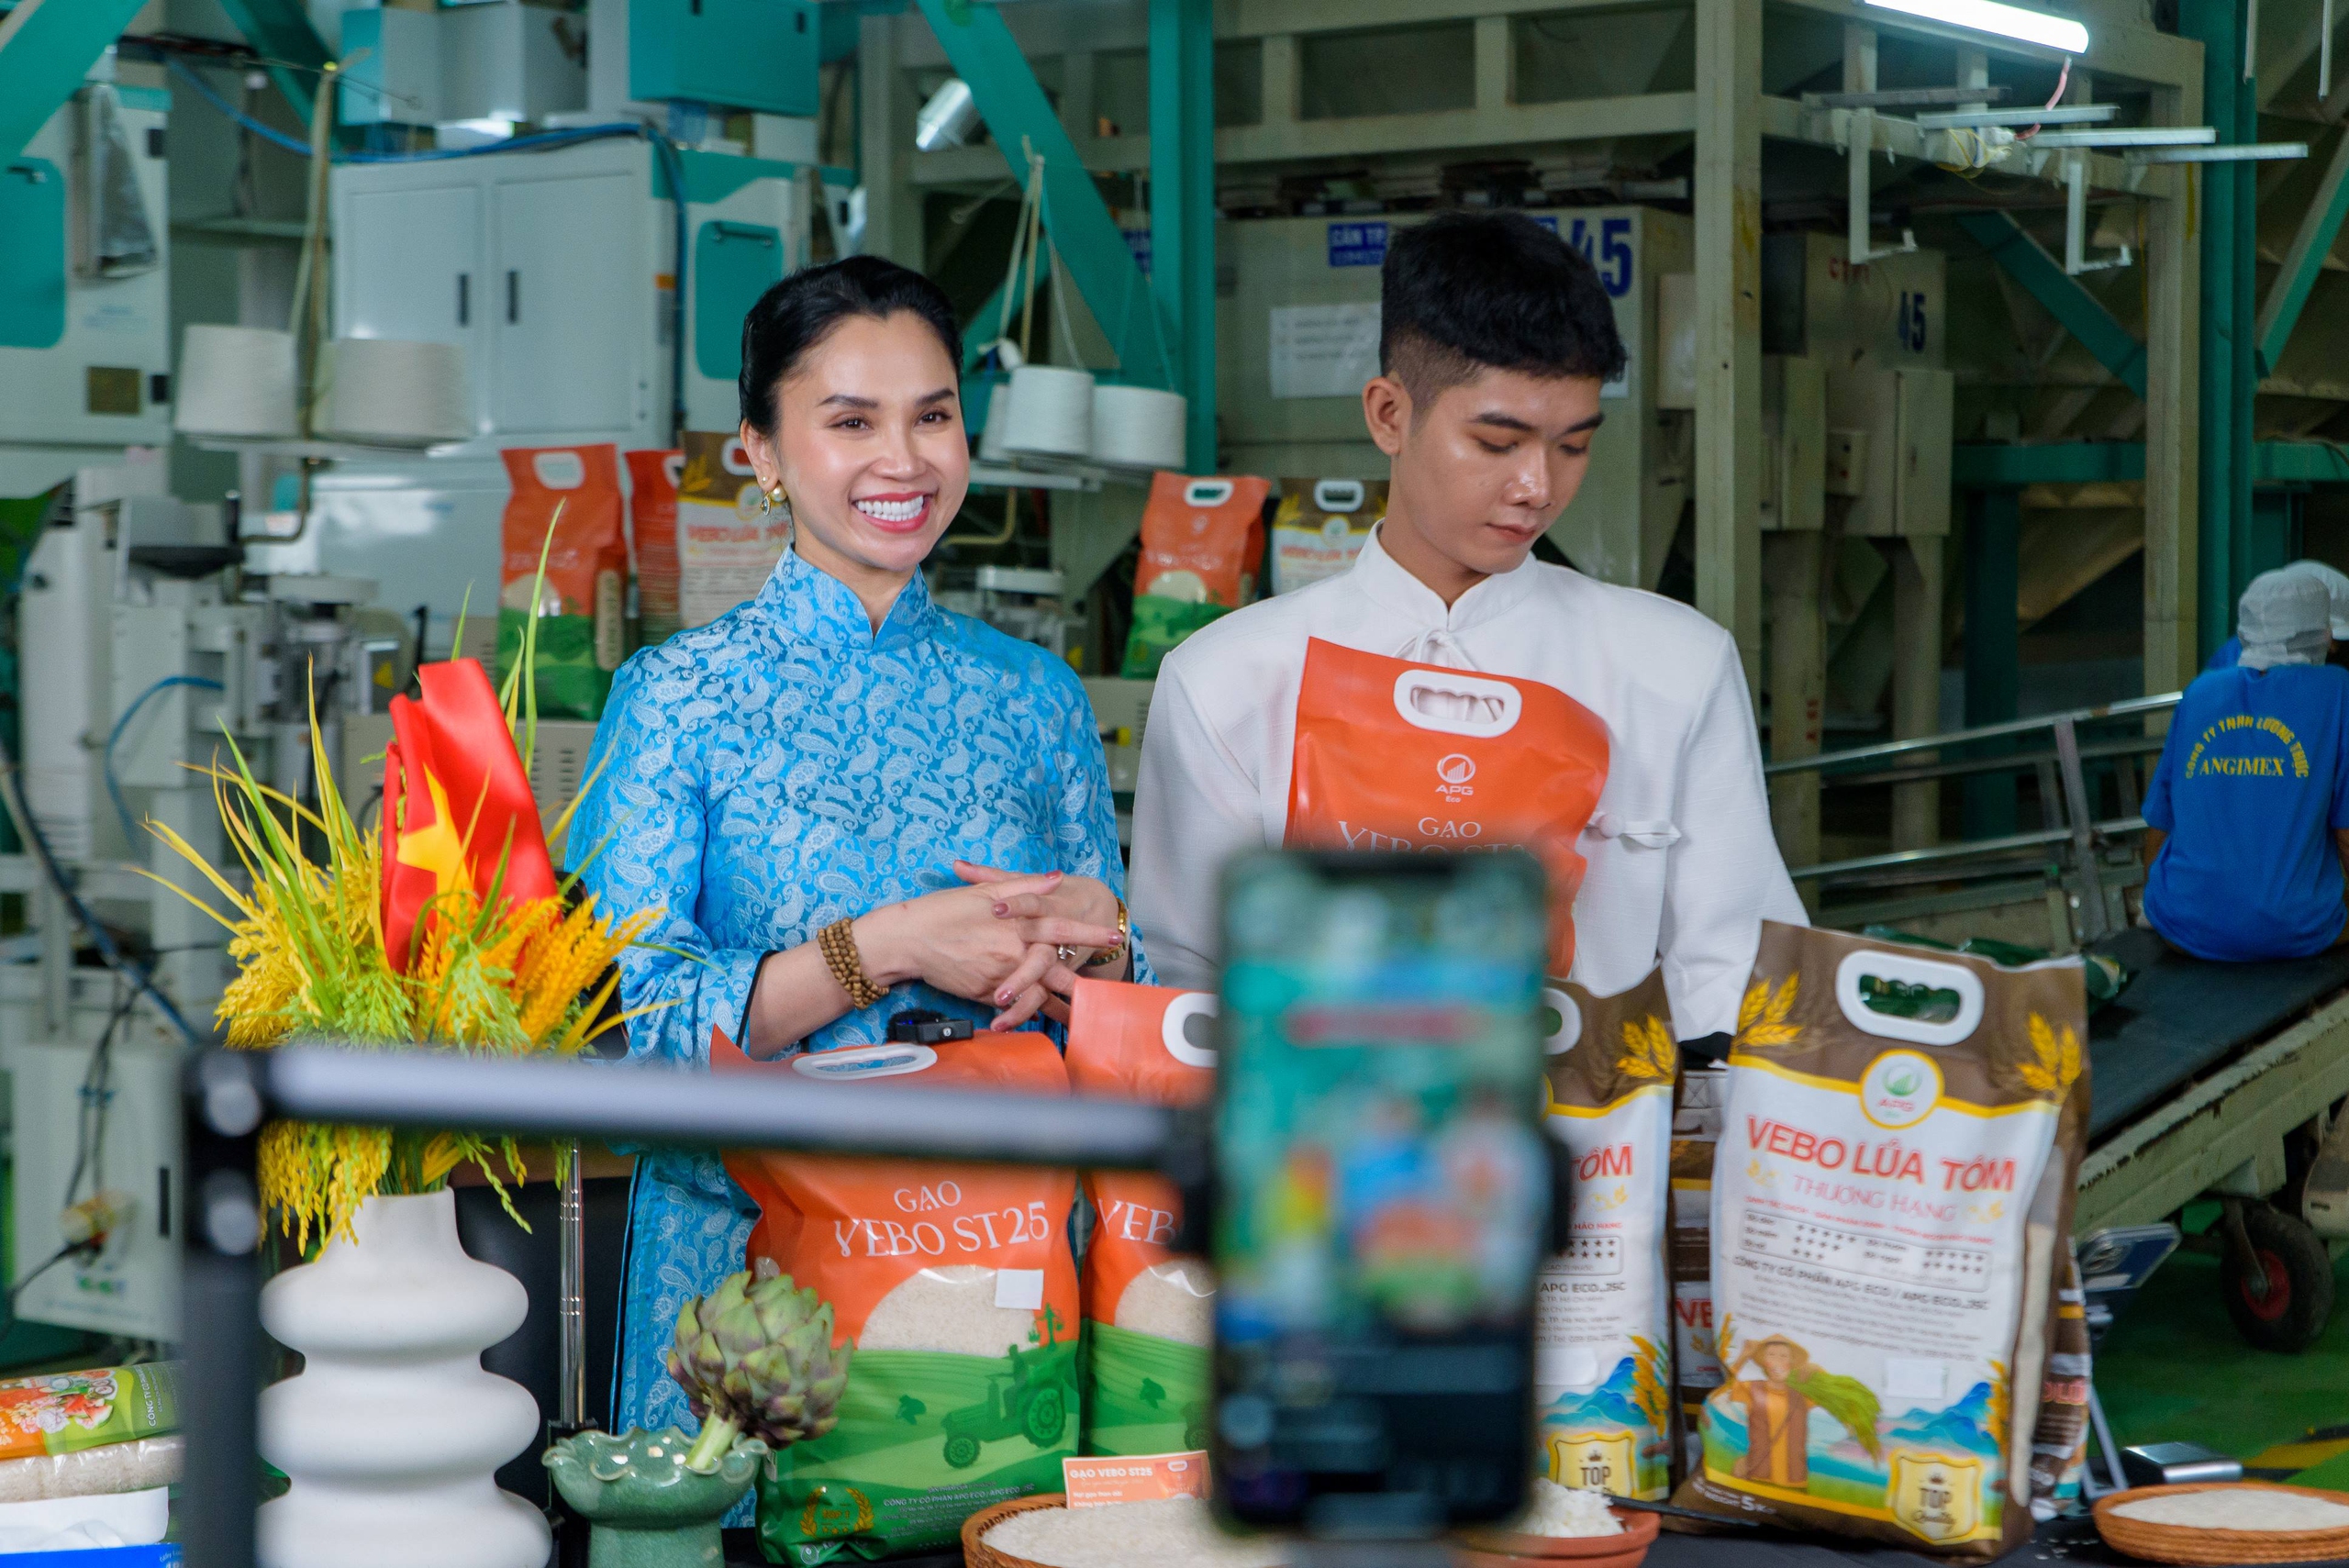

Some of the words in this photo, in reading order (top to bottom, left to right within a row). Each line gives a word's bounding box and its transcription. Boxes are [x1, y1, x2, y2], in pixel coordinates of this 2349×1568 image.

[2199, 757, 2284, 777] ANGIMEX
[1435, 784, 1474, 796] APG
[1747, 1115, 1846, 1171] VEBO
[834, 1218, 946, 1257] VEBO
[952, 1200, 1050, 1252] ST25
[1097, 1197, 1180, 1245] VEB
[1541, 1283, 1568, 1294] APG
[145, 1400, 156, 1427] CÔNG
[1097, 1468, 1127, 1478] VEBO
[1128, 1466, 1153, 1477] ST25
[1580, 1465, 1611, 1486] TOP
